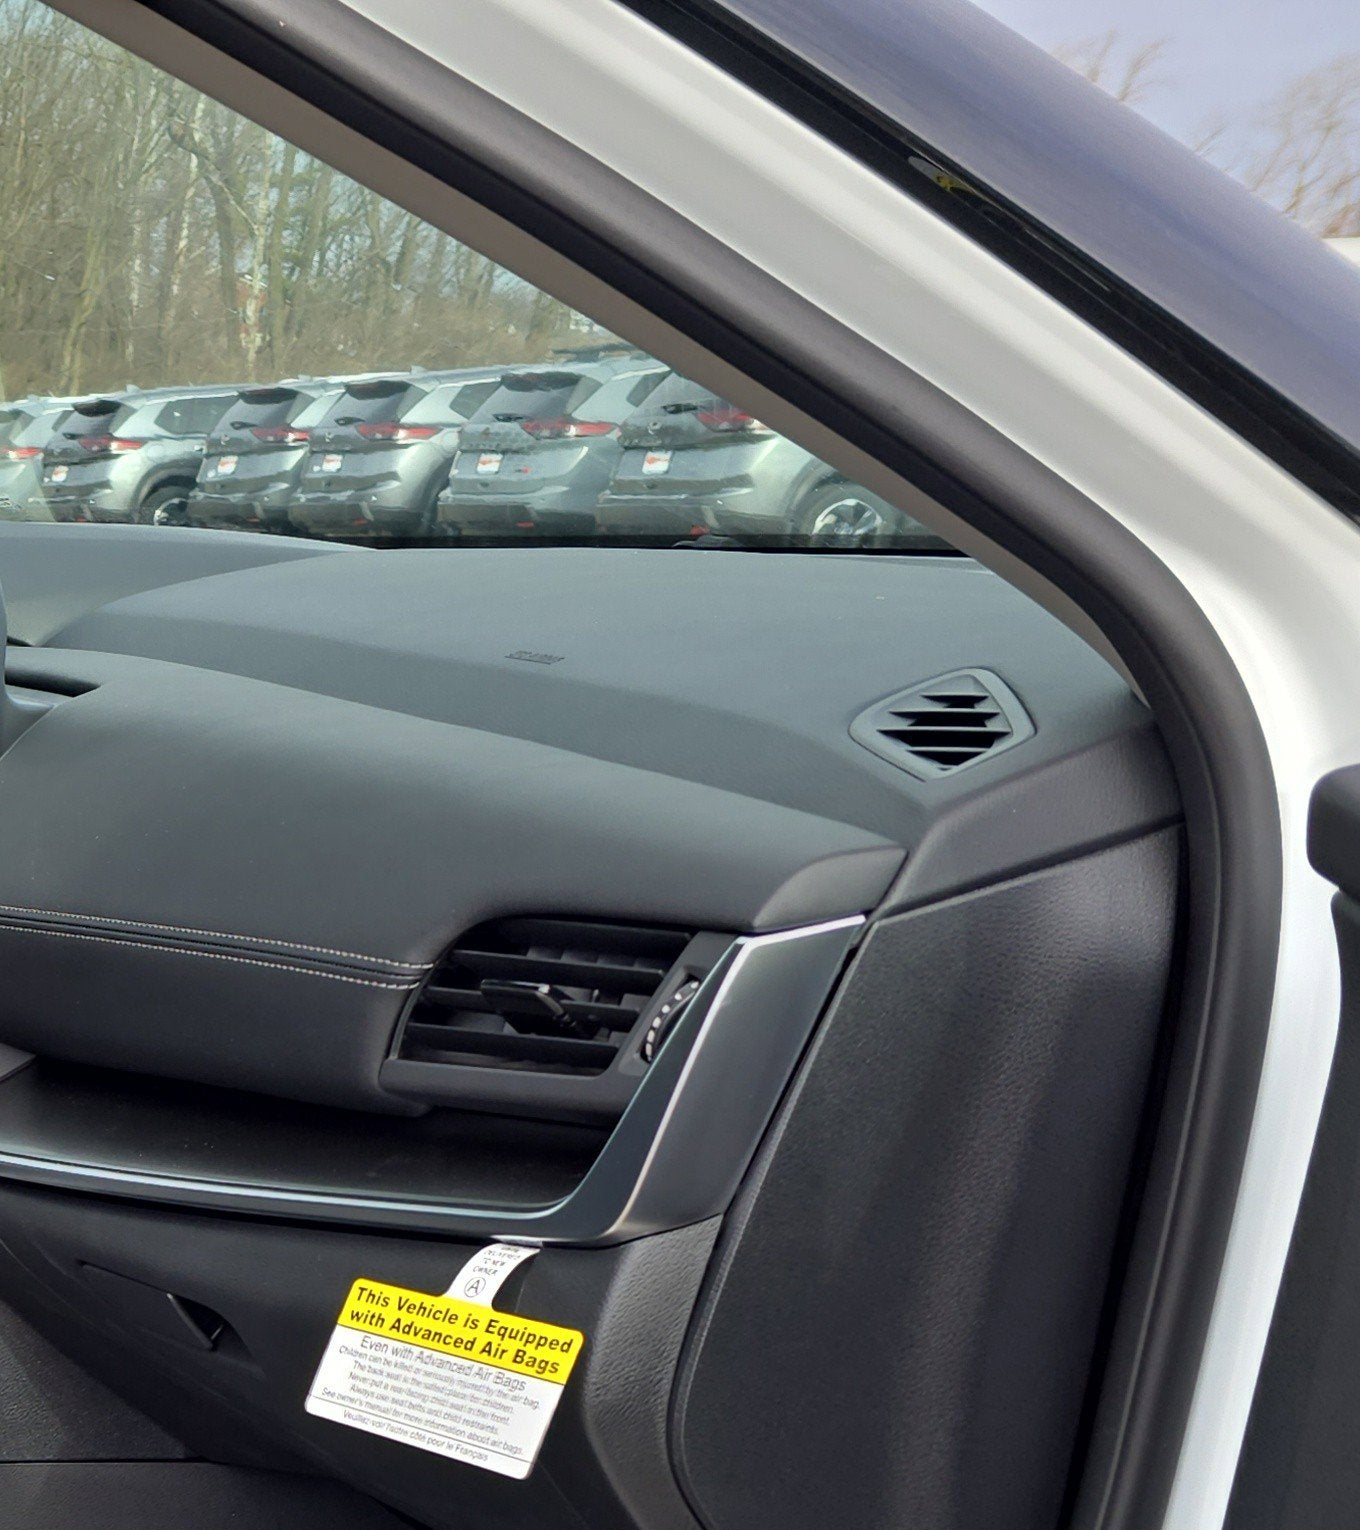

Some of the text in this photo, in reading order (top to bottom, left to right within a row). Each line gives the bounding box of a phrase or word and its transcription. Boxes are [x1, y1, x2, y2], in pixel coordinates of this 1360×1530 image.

[466, 1278, 482, 1296] A
[350, 1310, 559, 1375] with Advanced Air Bags
[357, 1286, 573, 1353] This Vehicle is Equipped
[339, 1345, 368, 1360] Children
[360, 1335, 526, 1392] Even with Advanced Air Bags
